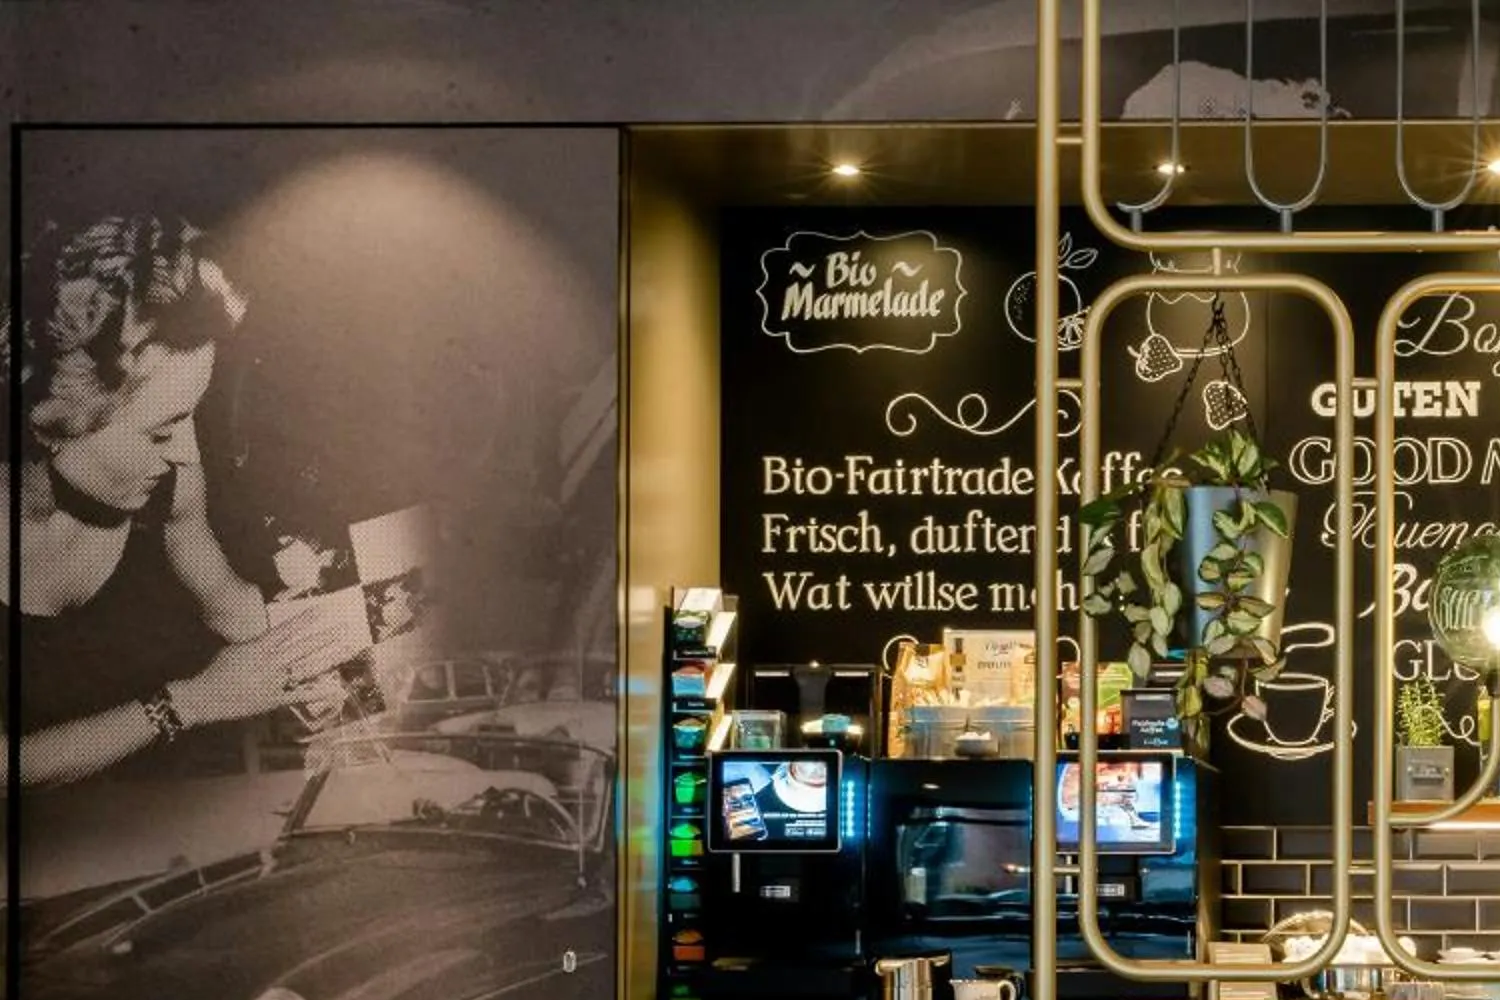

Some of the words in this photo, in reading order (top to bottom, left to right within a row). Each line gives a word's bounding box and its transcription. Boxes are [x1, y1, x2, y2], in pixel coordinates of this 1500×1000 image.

[826, 251, 878, 289] Bio
[781, 275, 946, 321] Marmelade
[1311, 380, 1481, 418] GUTEN
[762, 455, 1036, 496] Bio-Fairtrade
[1288, 436, 1474, 486] GOOD
[761, 511, 897, 558] Frisch,
[763, 571, 852, 611] Wat
[863, 571, 978, 611] willse
